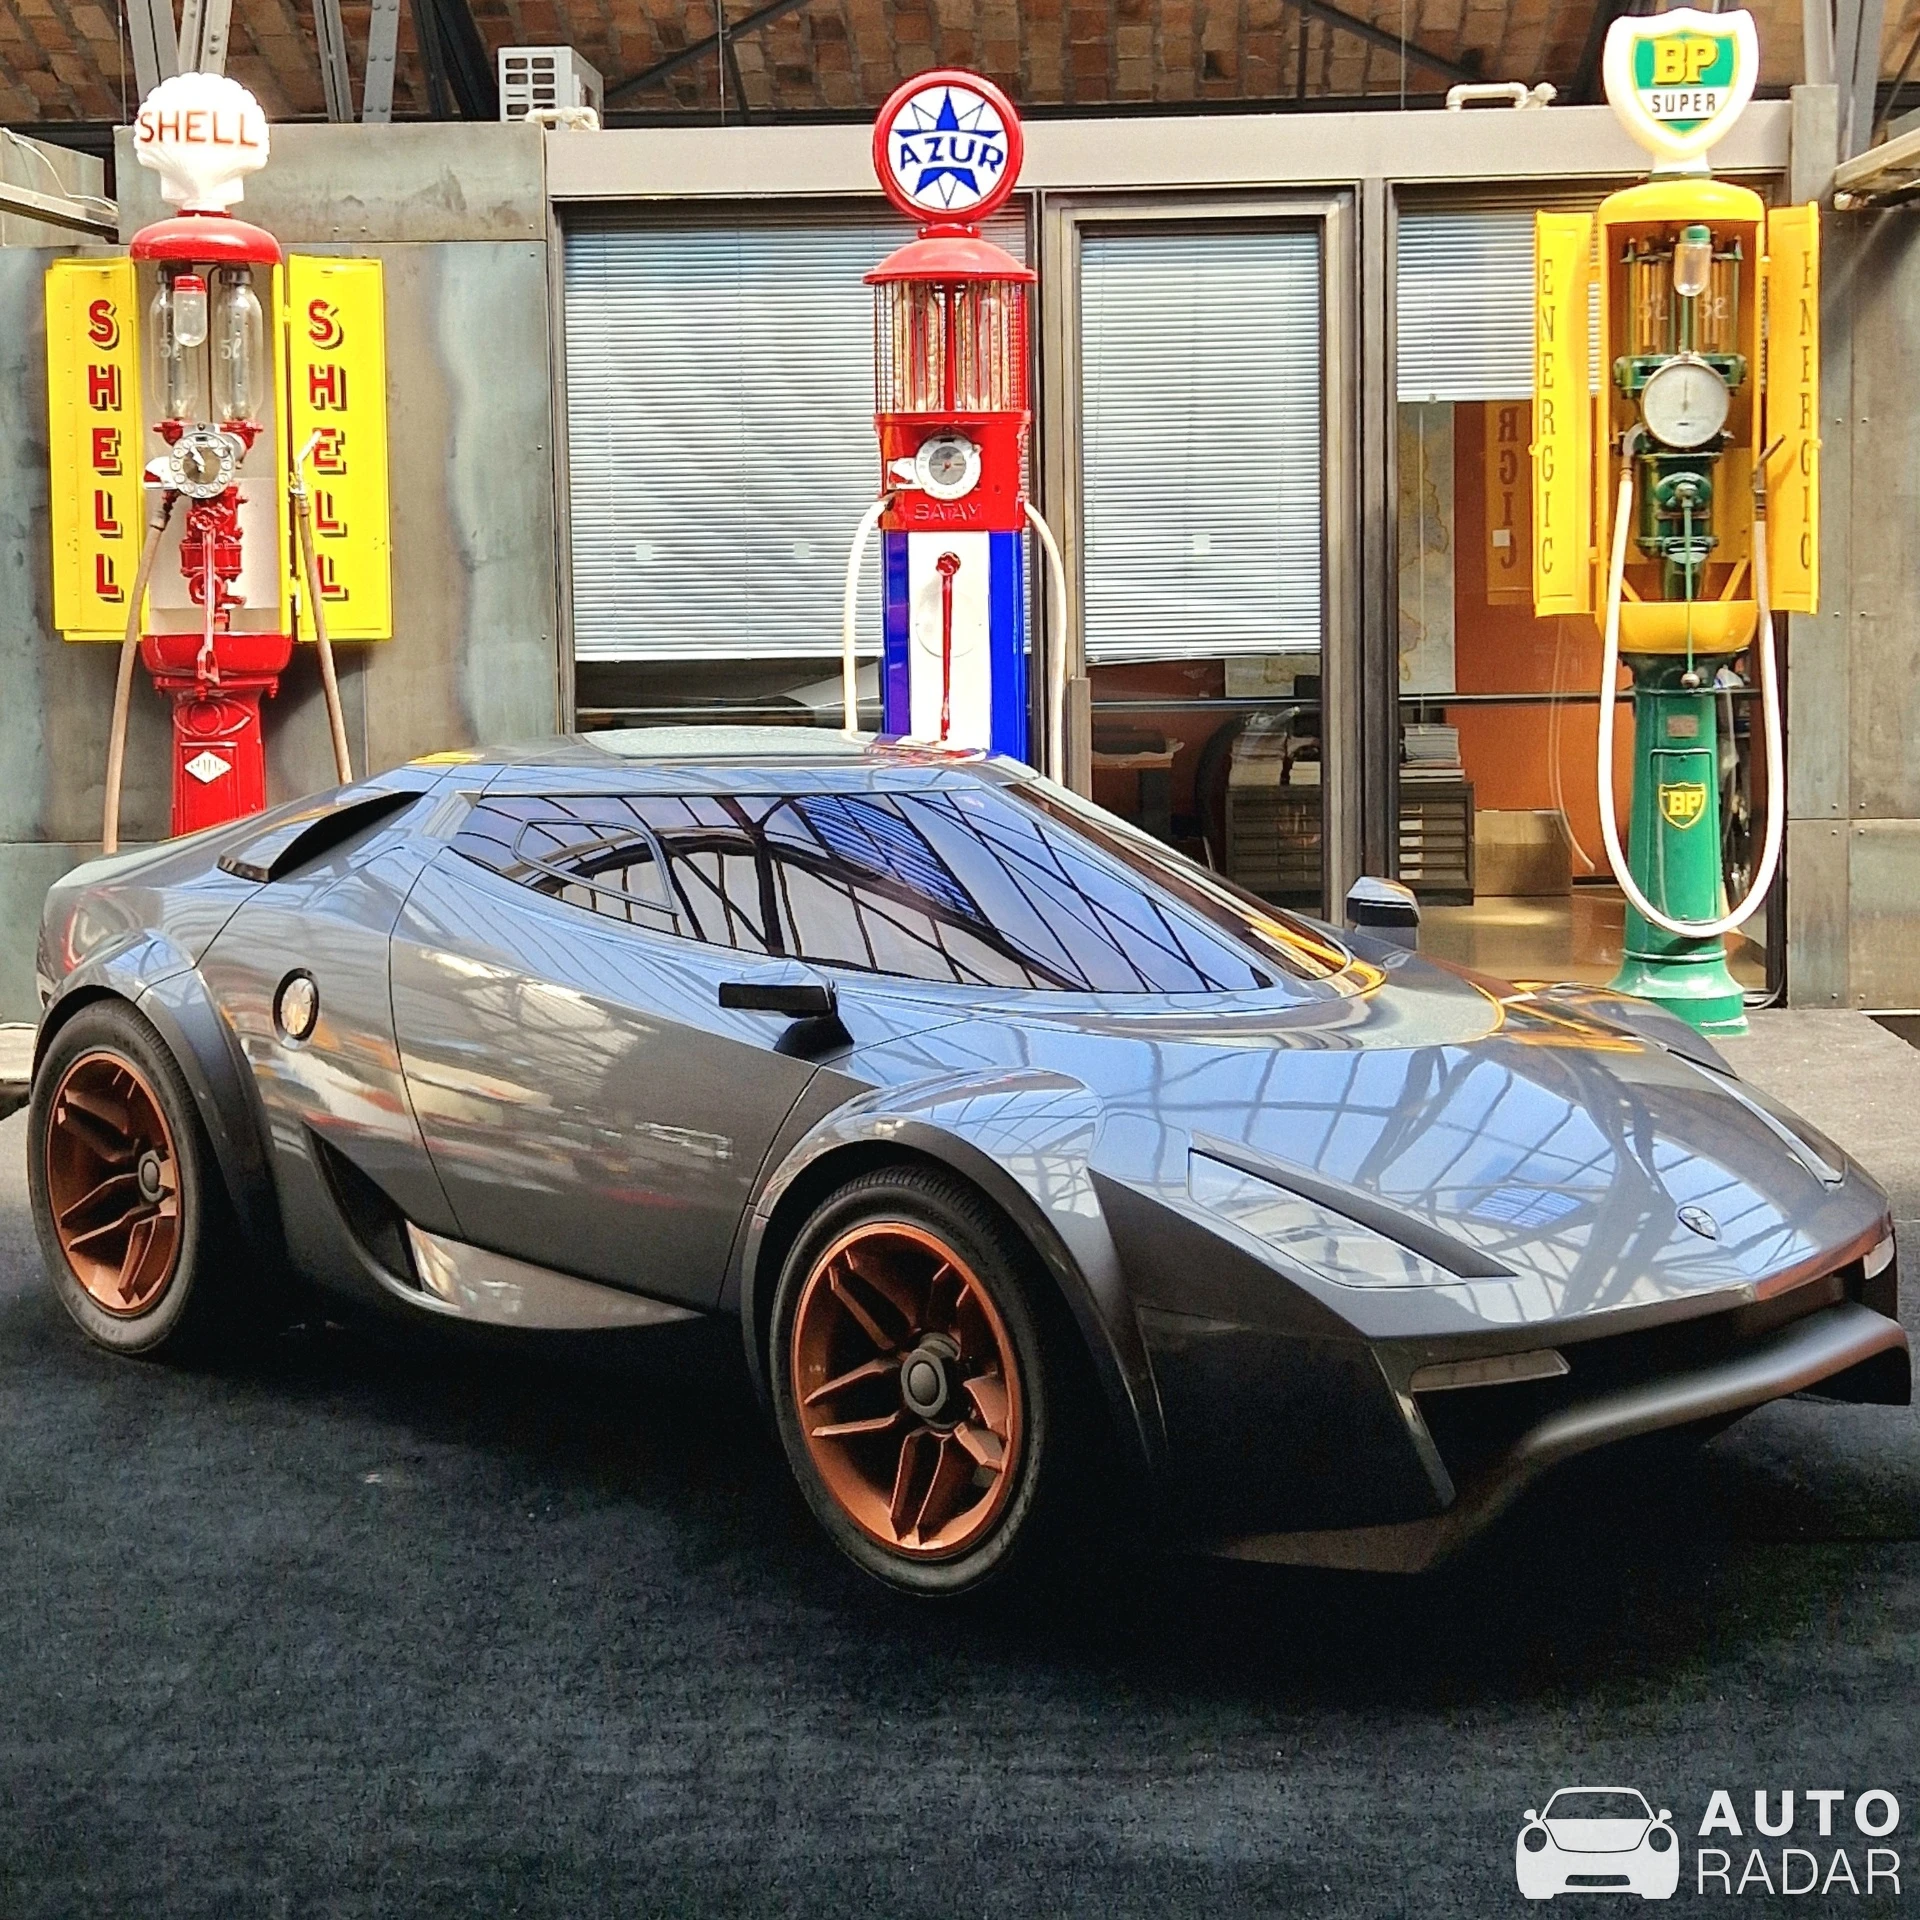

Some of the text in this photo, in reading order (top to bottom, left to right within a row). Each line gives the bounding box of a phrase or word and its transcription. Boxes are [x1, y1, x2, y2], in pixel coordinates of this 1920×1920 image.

[1653, 39, 1719, 85] BP
[1651, 93, 1716, 113] SUPER
[139, 110, 259, 147] SHELL
[899, 136, 1004, 175] AZUR
[1541, 258, 1556, 574] ENERGIC
[87, 298, 125, 604] SHELL
[307, 298, 350, 602] SHELL
[1668, 790, 1703, 816] BP
